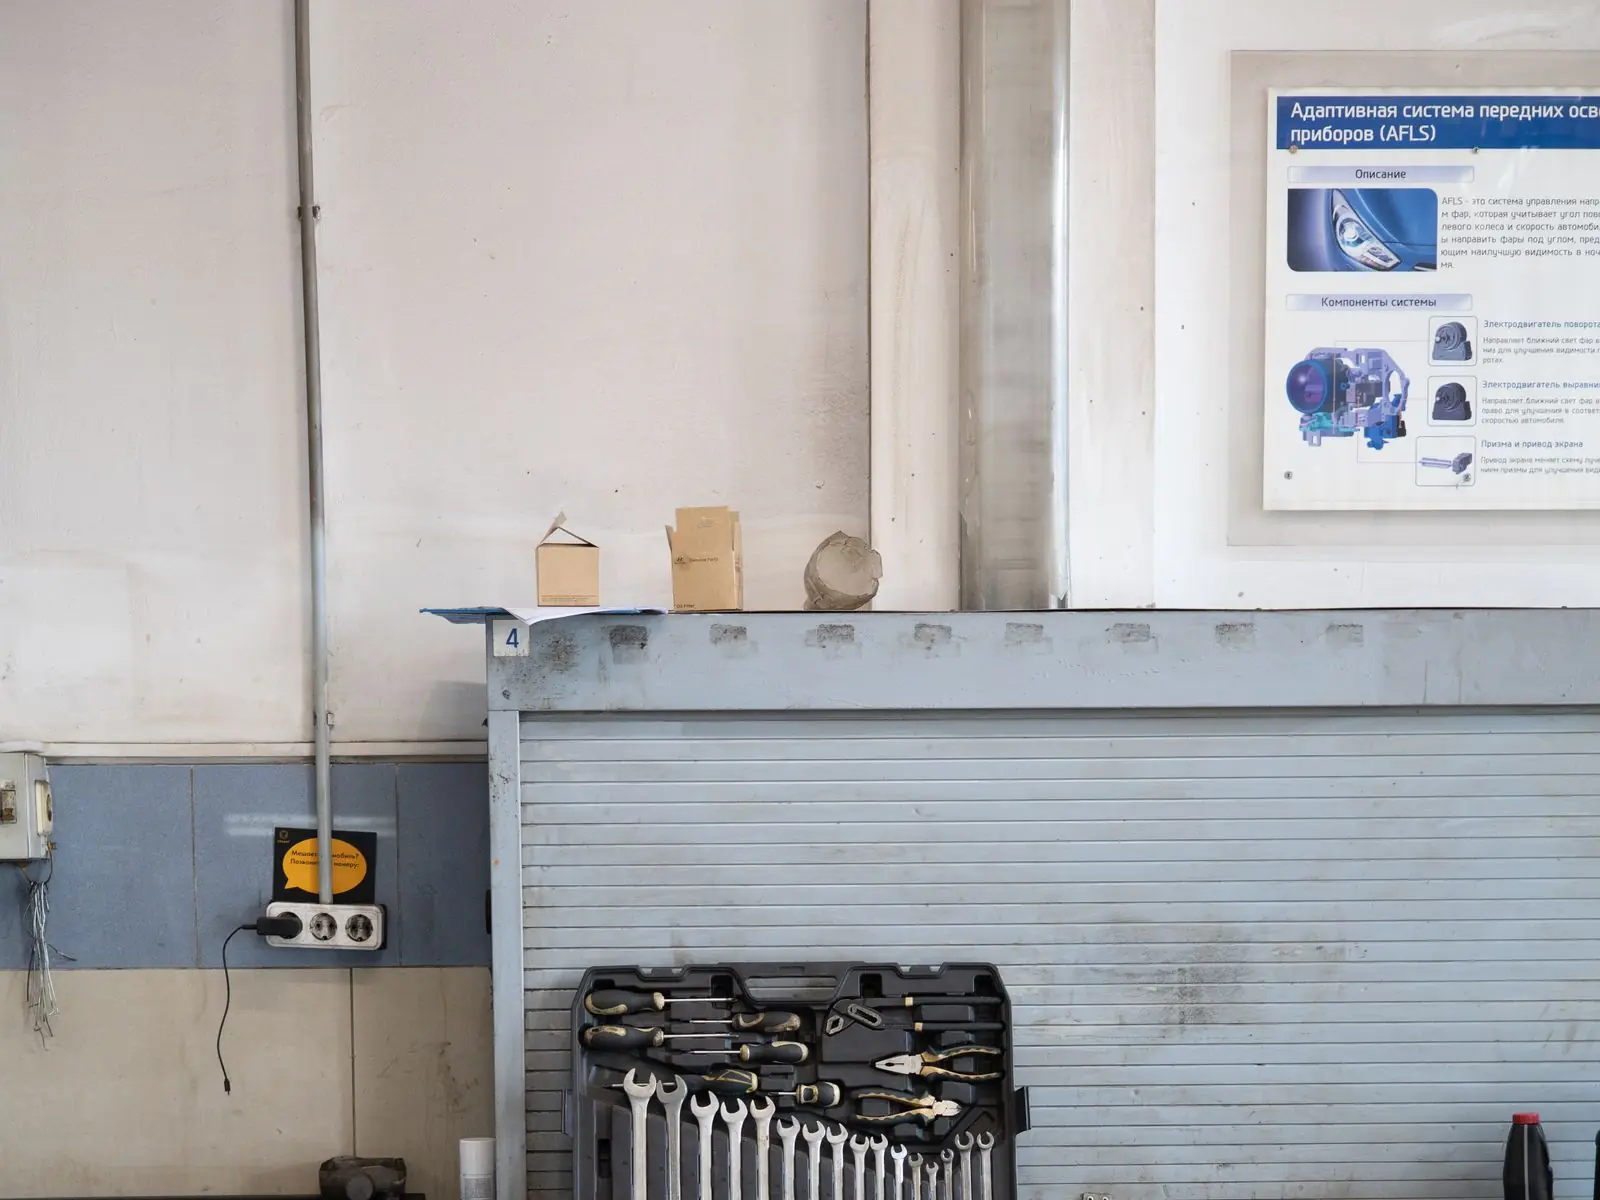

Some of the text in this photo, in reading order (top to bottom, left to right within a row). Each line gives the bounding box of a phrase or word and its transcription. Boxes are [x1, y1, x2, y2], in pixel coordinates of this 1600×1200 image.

[1291, 102, 1600, 121] Адаптивная система передних осв
[1290, 124, 1436, 144] приборов (AFLS)
[1355, 168, 1406, 181] Описание
[1442, 197, 1463, 206] AFLS
[1472, 198, 1485, 206] это
[1488, 198, 1523, 206] система
[1526, 198, 1577, 208] управления
[1474, 211, 1508, 219] которая
[1511, 211, 1556, 219] учитывает
[1560, 211, 1580, 219] угол
[1441, 223, 1471, 231] левого
[1474, 223, 1504, 231] колеса
[1516, 223, 1554, 231] скорость
[1557, 222, 1600, 231] автомоби
[1452, 236, 1497, 244] направить
[1500, 235, 1525, 244] фары
[1528, 236, 1544, 244] под
[1441, 249, 1468, 257] ющим
[1471, 249, 1521, 258] наилучшую
[1525, 249, 1573, 257] видимость
[1321, 297, 1437, 307] Компоненты системы
[1483, 319, 1562, 329] Электродвигатель
[1482, 380, 1560, 390] Электродвигатель
[1481, 440, 1512, 449] Призма
[1522, 441, 1553, 449] привод
[1554, 441, 1584, 449] экрана
[506, 627, 519, 648] 4
